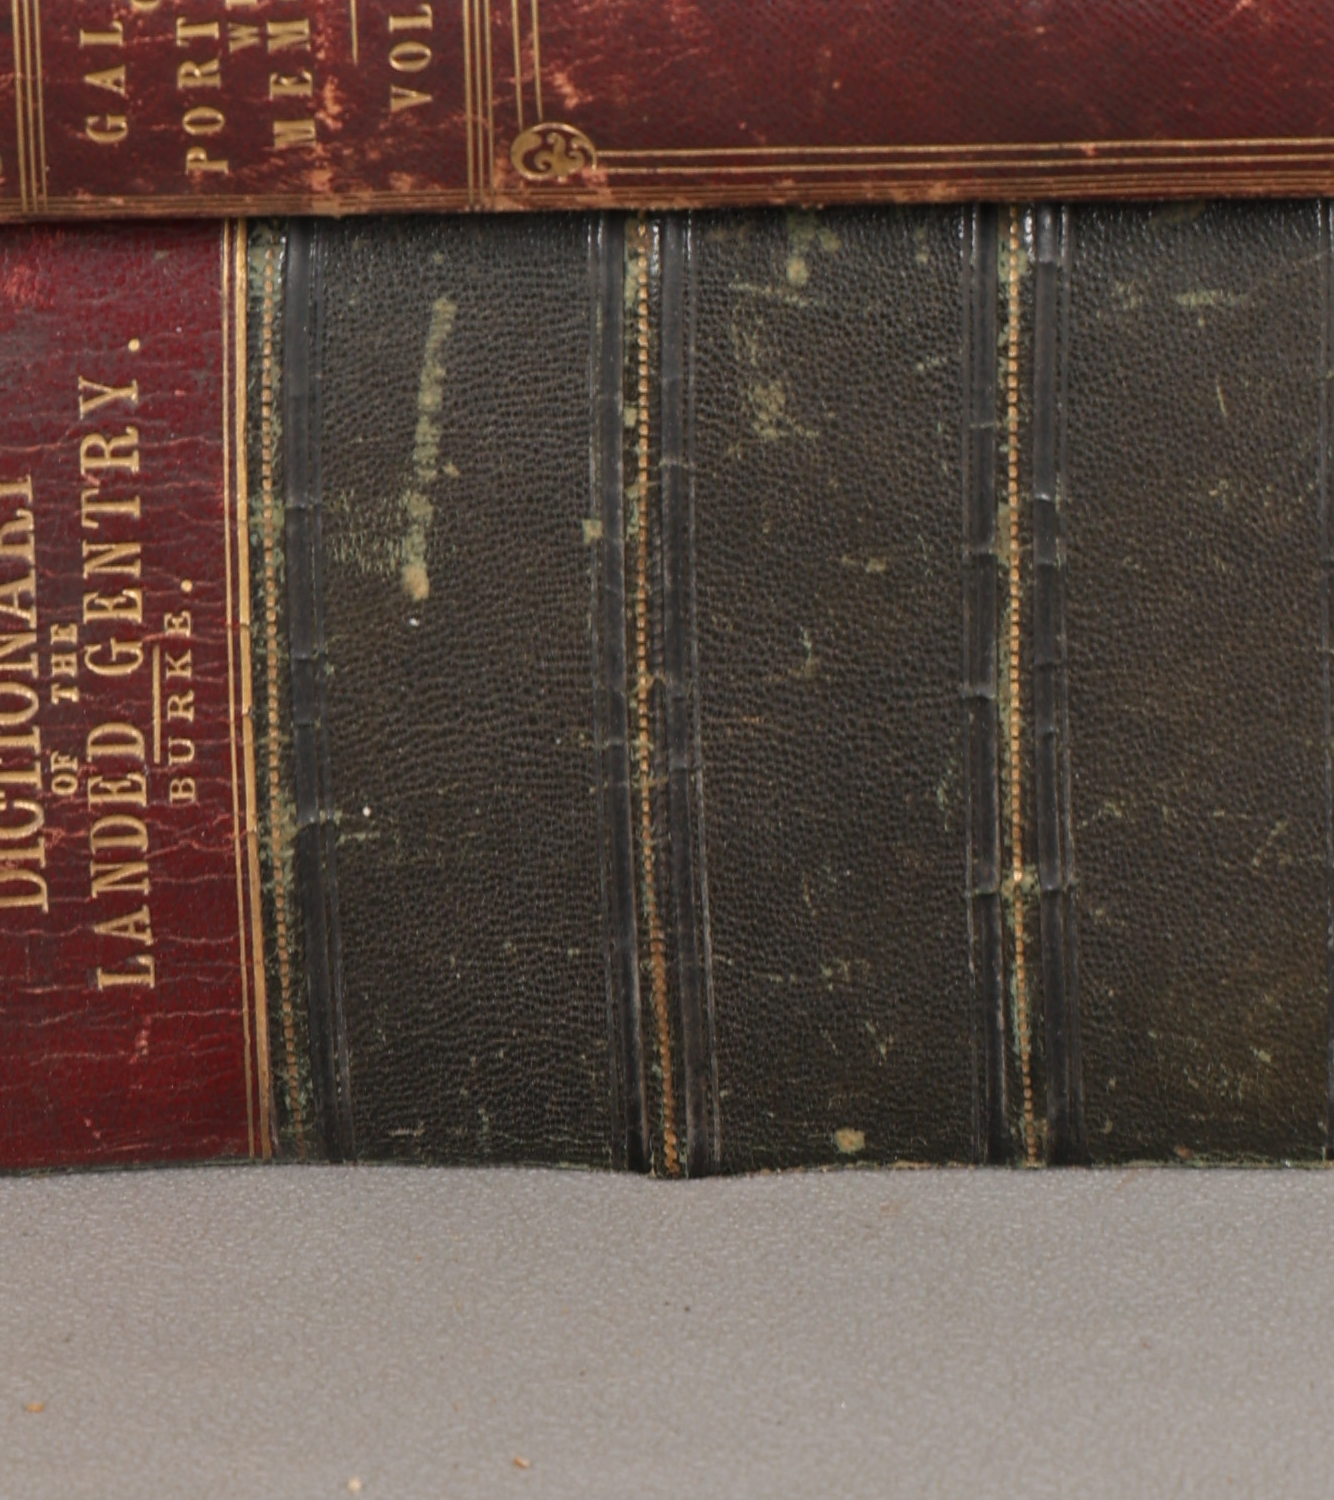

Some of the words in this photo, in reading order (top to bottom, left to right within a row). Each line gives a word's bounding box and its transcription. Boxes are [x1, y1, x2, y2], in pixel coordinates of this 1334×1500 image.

[77, 338, 148, 676] GENTRY.
[49, 623, 79, 703] THE
[51, 752, 79, 796] OF
[164, 578, 197, 803] BURKE.
[85, 721, 157, 991] LANDED
